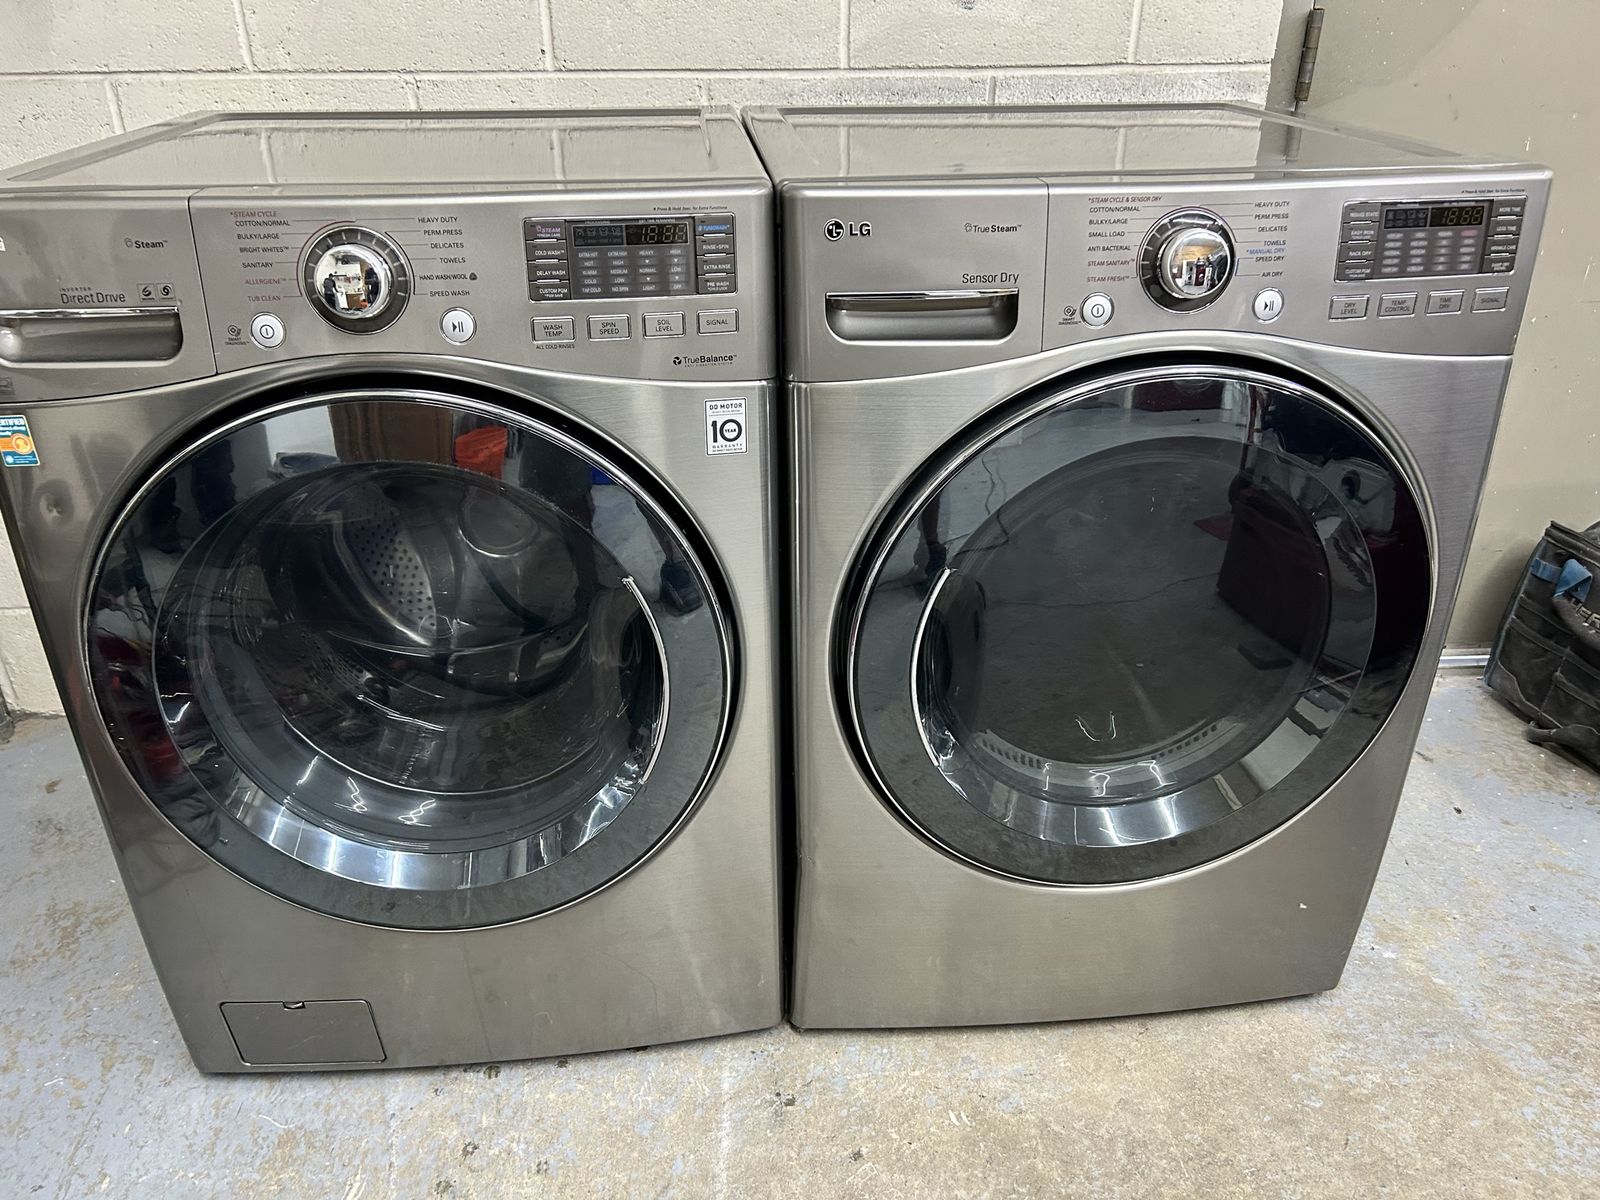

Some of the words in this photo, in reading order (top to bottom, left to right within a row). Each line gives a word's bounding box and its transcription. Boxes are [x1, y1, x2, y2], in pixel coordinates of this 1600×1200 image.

[849, 222, 872, 236] LG
[962, 273, 998, 284] Sensor
[1000, 273, 1019, 284] Dry
[60, 293, 95, 304] Direct
[96, 292, 126, 303] Drive
[711, 418, 742, 443] 10
